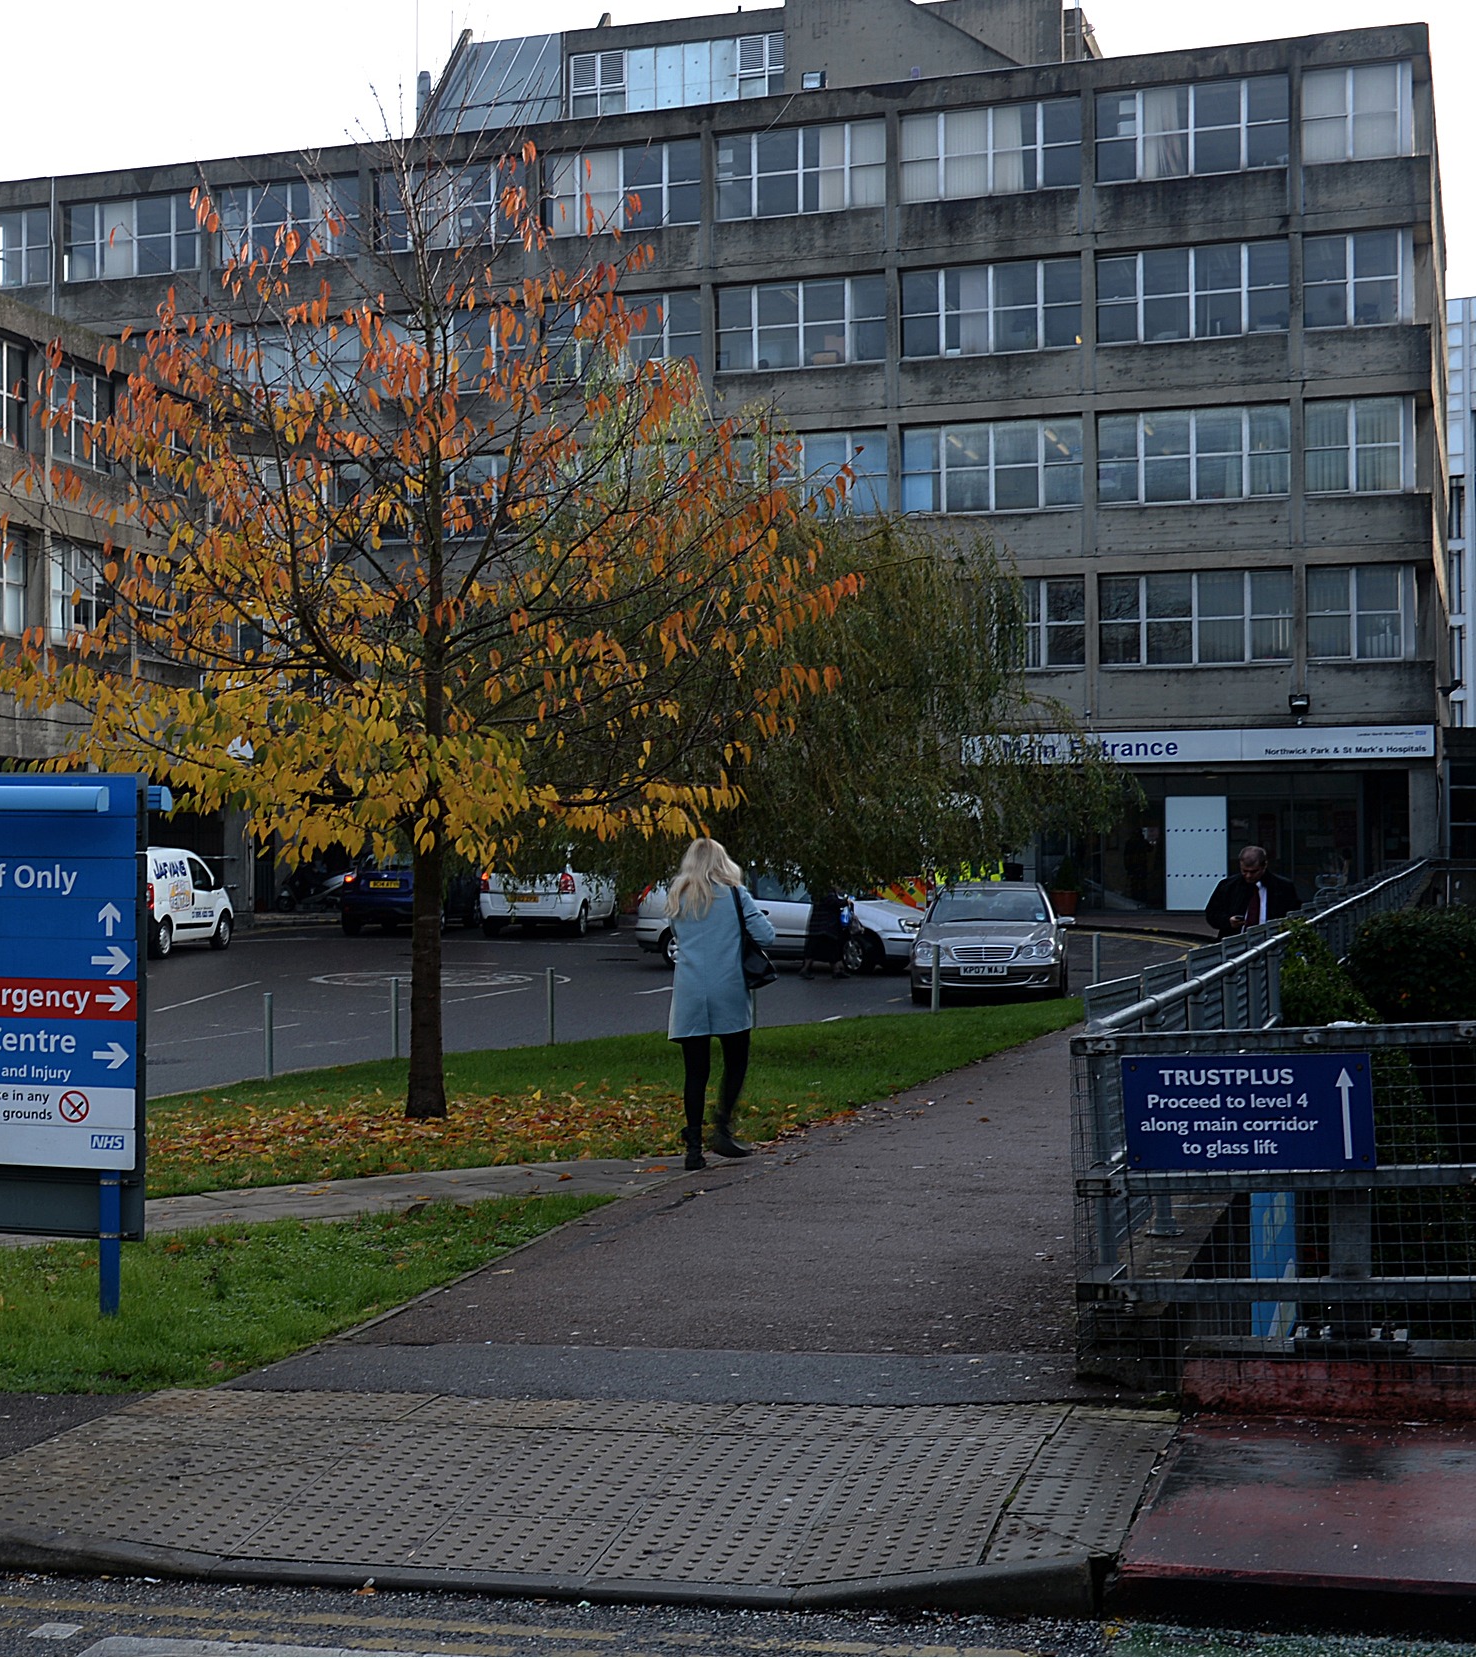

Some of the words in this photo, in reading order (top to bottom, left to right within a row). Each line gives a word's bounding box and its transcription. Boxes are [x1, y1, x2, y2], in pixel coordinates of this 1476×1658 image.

[1311, 747, 1330, 755] Park
[1343, 746, 1352, 754] St
[1355, 746, 1383, 754] Mark's
[1386, 745, 1427, 755] Hospitals
[15, 864, 77, 895] Only
[2, 1065, 27, 1077] and
[32, 1066, 71, 1082] Injury
[1159, 1069, 1293, 1085] TRUSTPLUS
[13, 1090, 23, 1101] in
[27, 1093, 49, 1105] any
[1148, 1094, 1220, 1108] Proceed
[1226, 1096, 1245, 1108] to
[1251, 1094, 1291, 1107] level
[1297, 1093, 1308, 1107] 4
[3, 1109, 52, 1121] grounds
[1141, 1117, 1188, 1135] along
[1194, 1117, 1237, 1131] main
[1243, 1117, 1318, 1131] corridor
[92, 1136, 123, 1149] NHS
[1182, 1142, 1201, 1154] to
[1207, 1140, 1249, 1158] glass
[1254, 1140, 1278, 1154] lift
